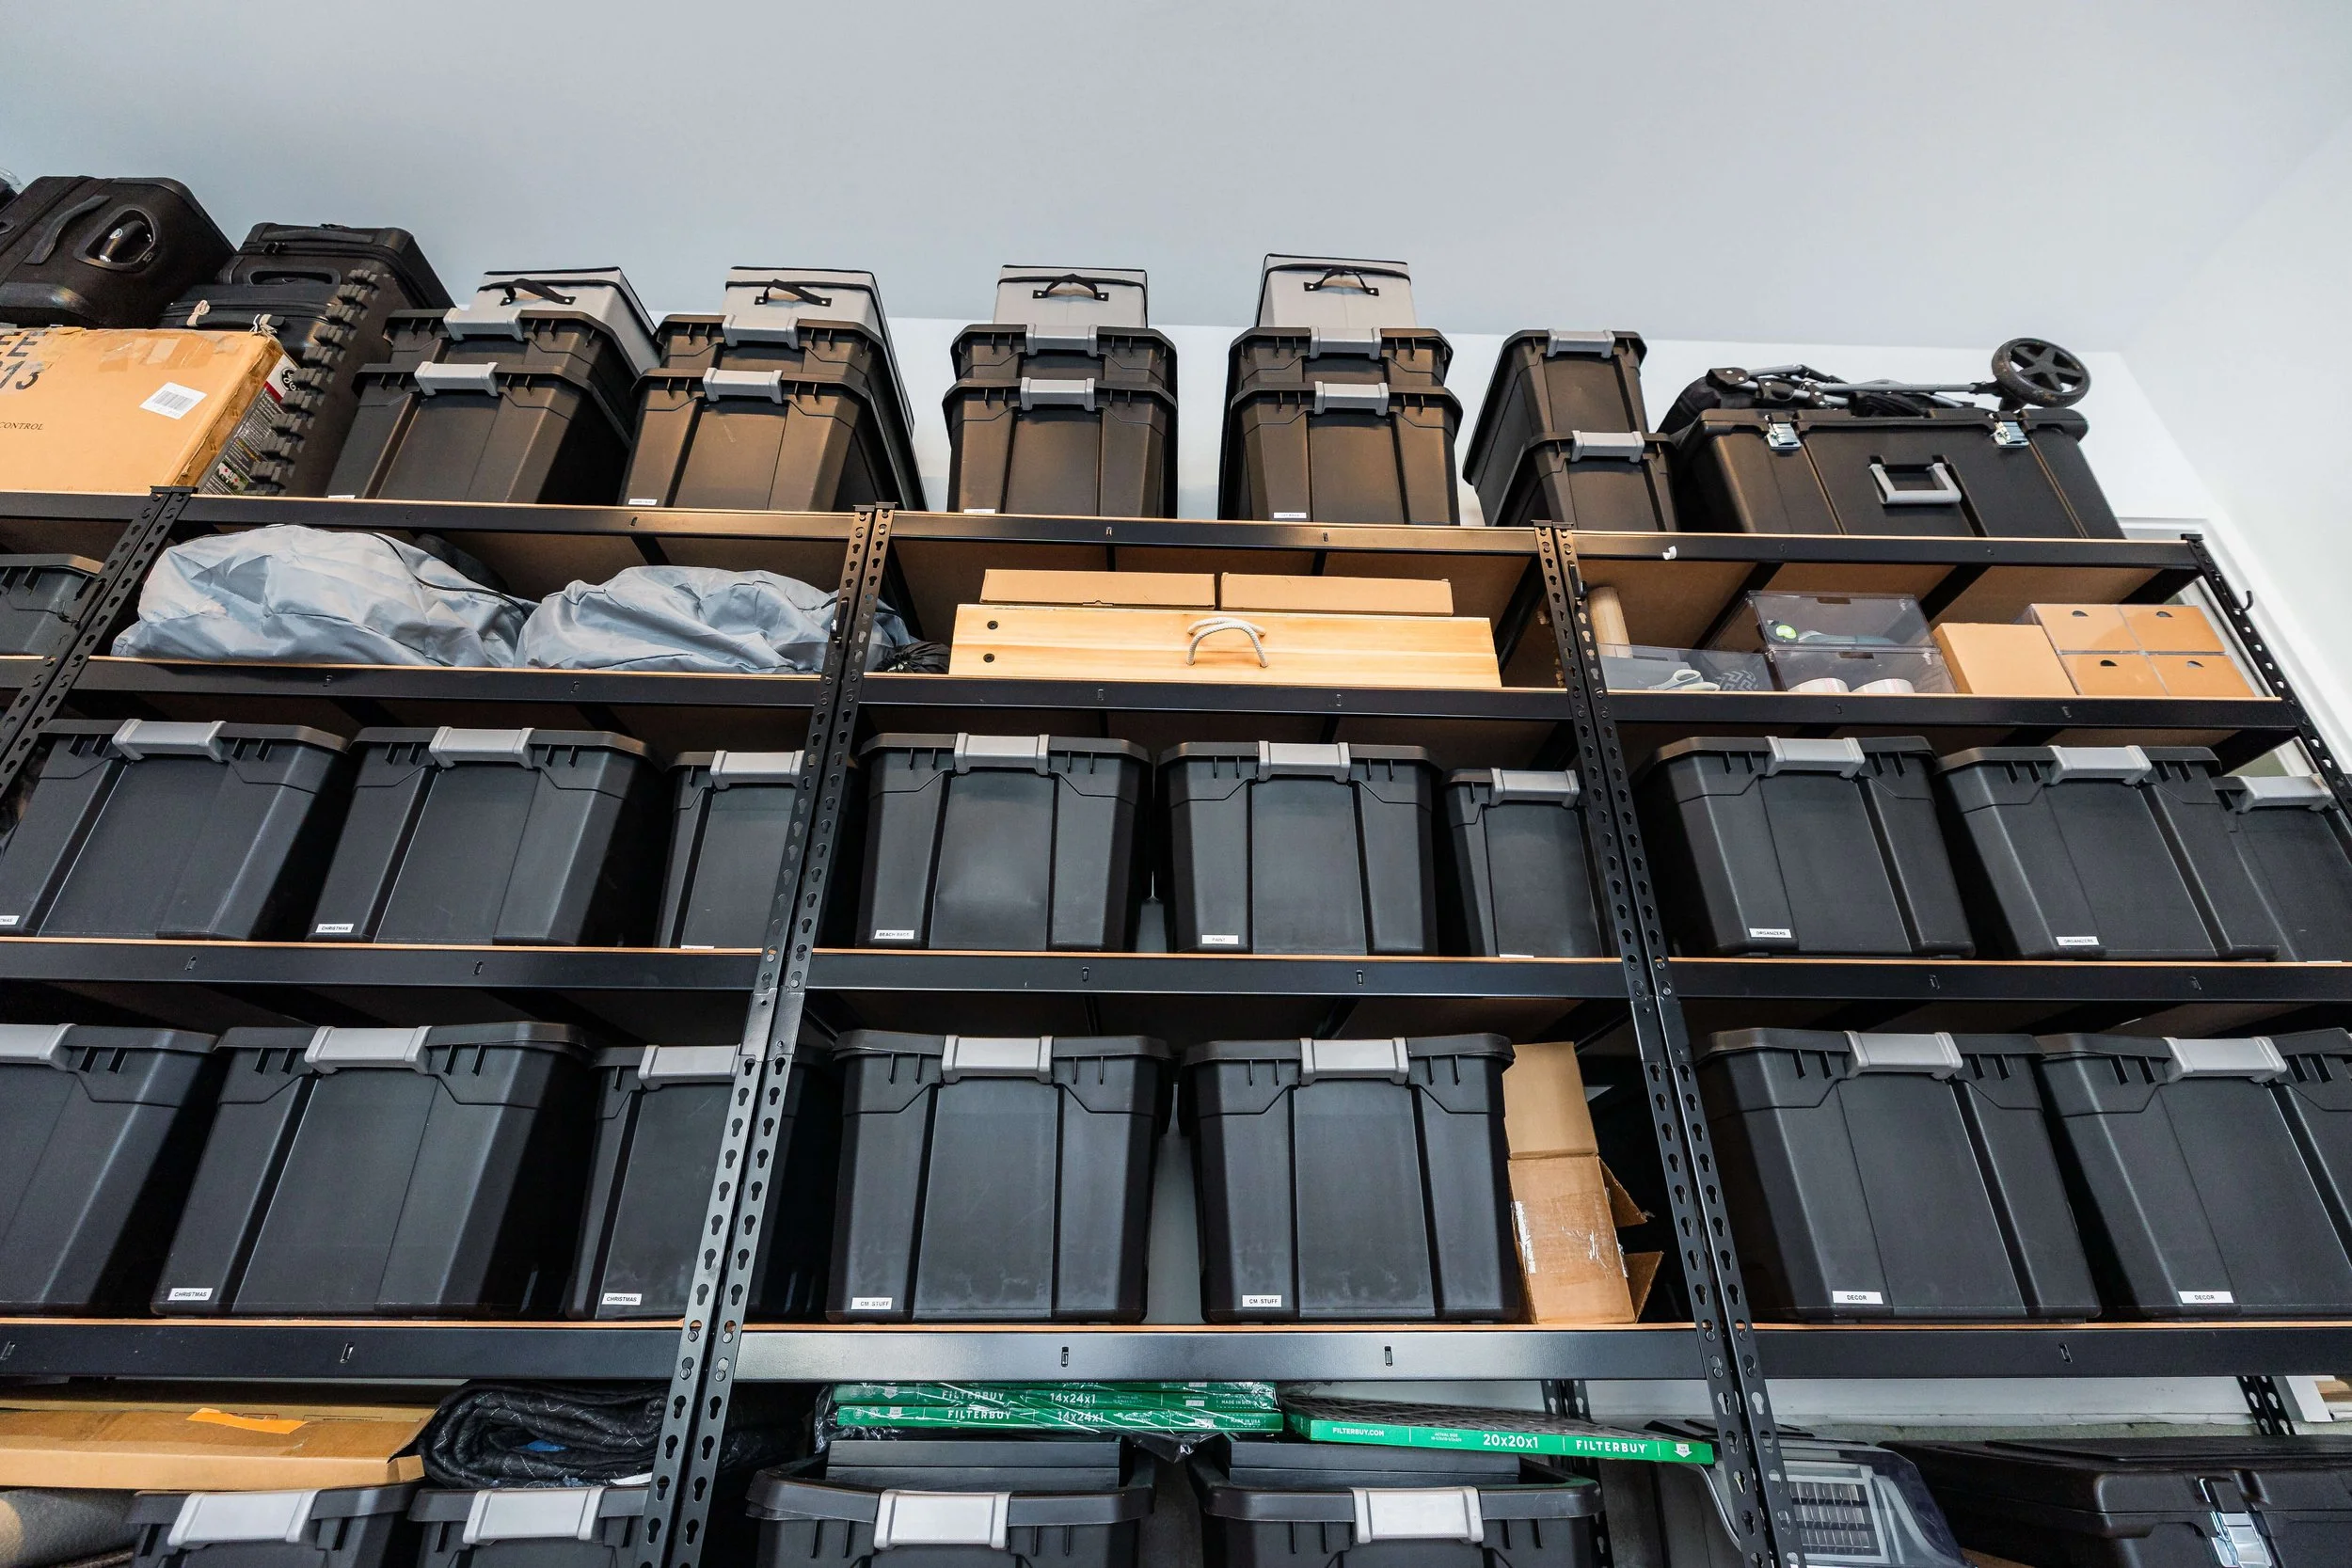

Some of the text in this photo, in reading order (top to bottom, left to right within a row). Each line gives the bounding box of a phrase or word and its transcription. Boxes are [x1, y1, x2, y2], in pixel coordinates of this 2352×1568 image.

[942, 1390, 1005, 1401] FILTERBUY
[1050, 1392, 1096, 1404] 14x24x1
[947, 1410, 1011, 1420] FILTERBUY
[1057, 1411, 1104, 1422] 14x24x1
[1332, 1427, 1385, 1437] FILTERBUY.COM
[1483, 1433, 1539, 1449] 20x20x1
[1576, 1440, 1646, 1454] FILTERBUY
